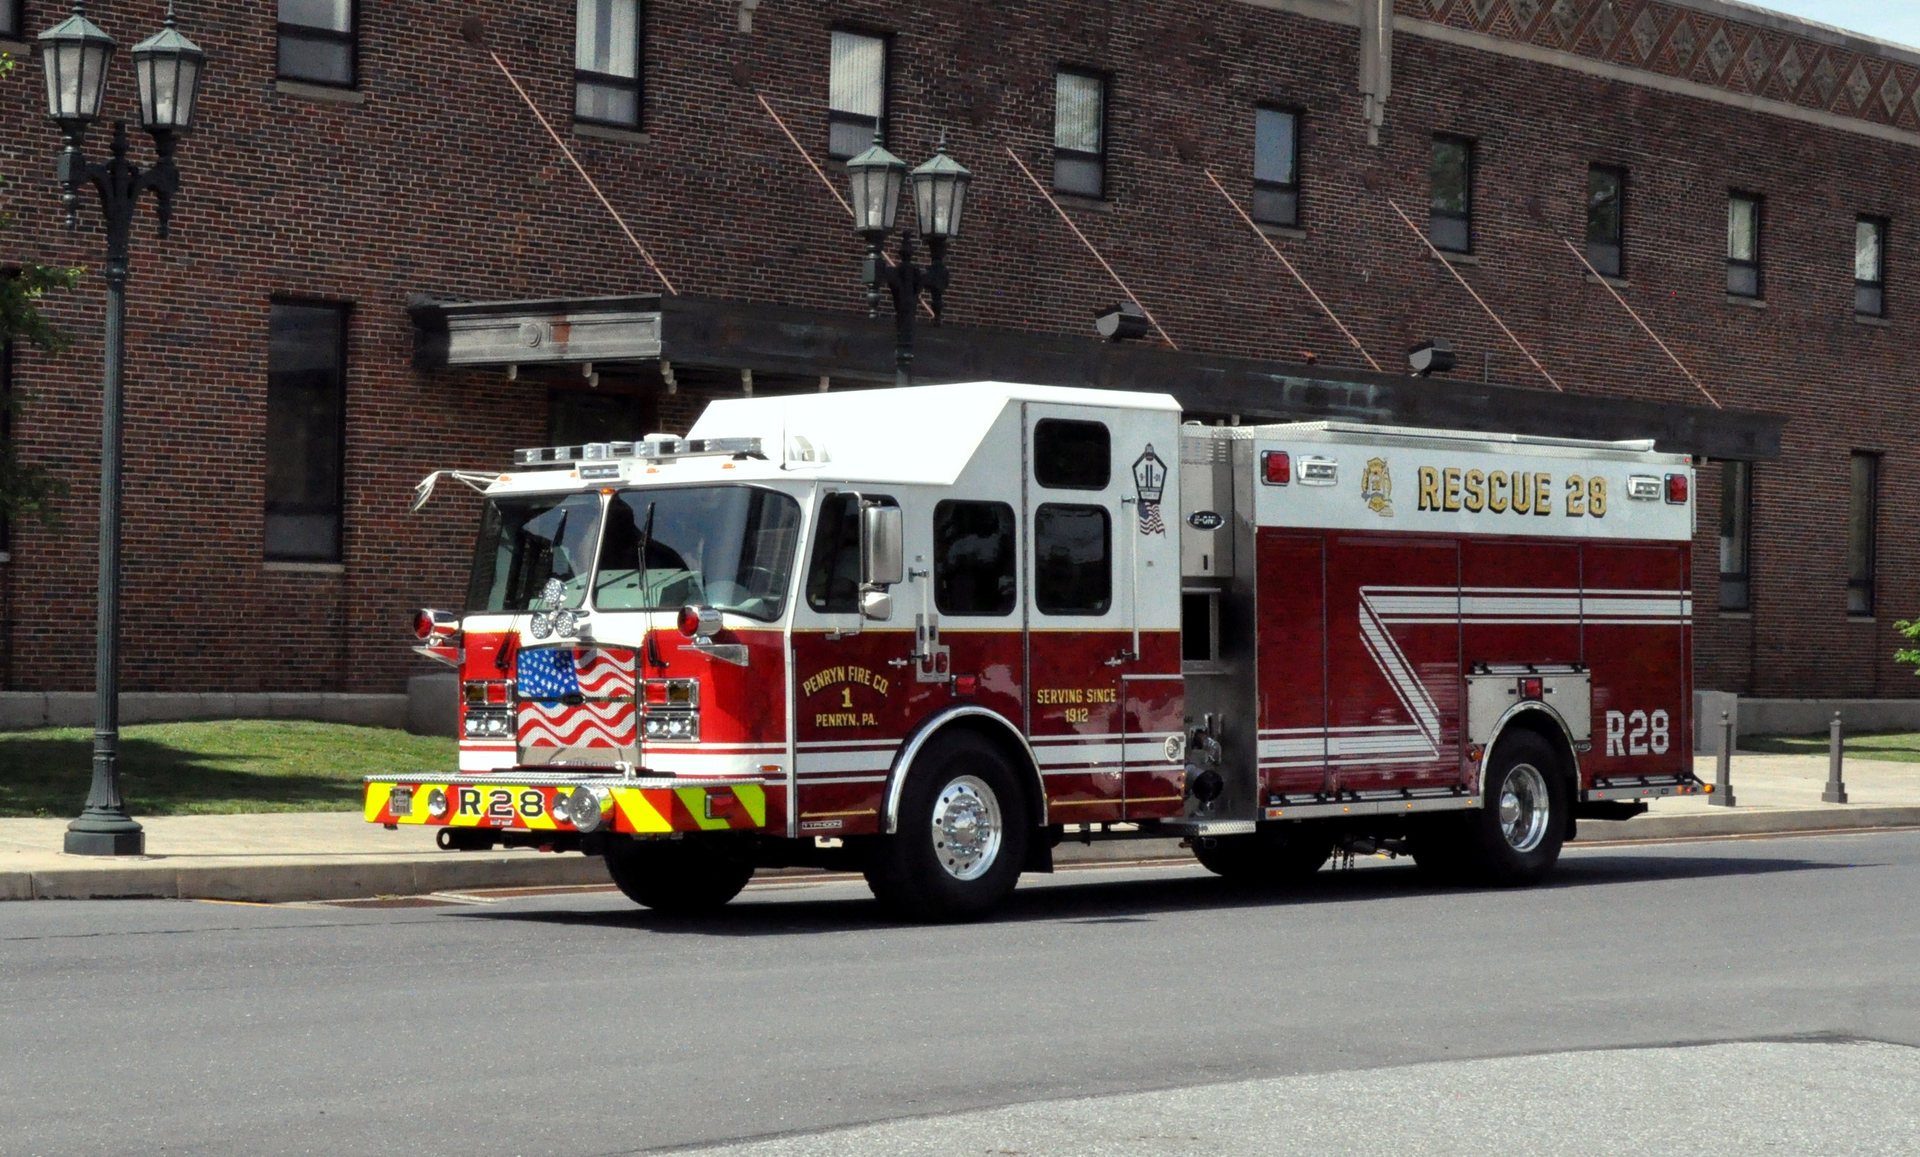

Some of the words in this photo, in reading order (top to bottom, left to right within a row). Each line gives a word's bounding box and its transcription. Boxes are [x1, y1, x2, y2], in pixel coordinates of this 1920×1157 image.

[1418, 466, 1551, 516] RESCUE
[1566, 474, 1607, 518] 28
[803, 666, 845, 697] PENRYN
[848, 666, 871, 685] FIRE
[873, 674, 888, 698] CO.
[842, 687, 853, 708] 1
[1037, 689, 1083, 704] SERVING
[1086, 688, 1116, 703] SINCE
[862, 713, 878, 726] PA.
[1065, 708, 1089, 722] 1912
[1606, 709, 1670, 757] R28
[458, 786, 545, 818] R28
